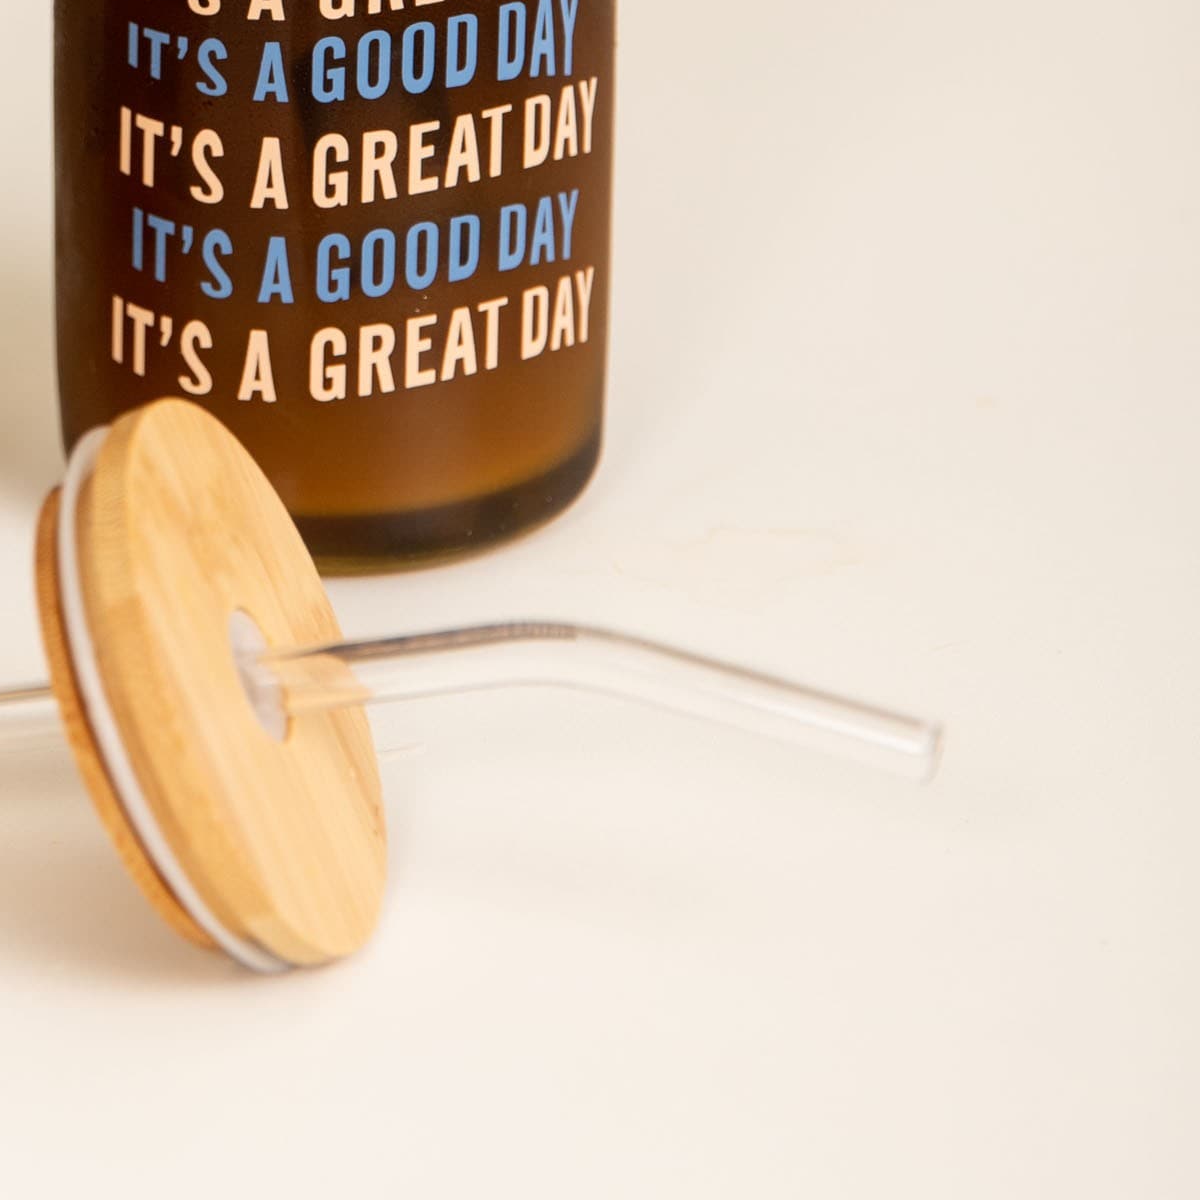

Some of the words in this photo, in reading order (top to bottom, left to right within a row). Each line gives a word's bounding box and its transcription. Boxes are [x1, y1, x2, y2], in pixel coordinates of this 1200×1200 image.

[127, 22, 228, 97] IT'S
[253, 41, 289, 103] A
[311, 13, 479, 105] GOOD
[120, 106, 225, 204] IT'S
[250, 136, 289, 210] A
[312, 103, 514, 209] GREAT
[523, 76, 599, 170] DAY
[132, 207, 234, 299] IT'S
[258, 236, 294, 304] A
[316, 214, 481, 303] GOOD
[498, 189, 580, 272] DAY
[112, 295, 214, 395] IT'S
[238, 329, 277, 403] A
[309, 296, 510, 402] GREAT
[521, 265, 595, 361] DAY
